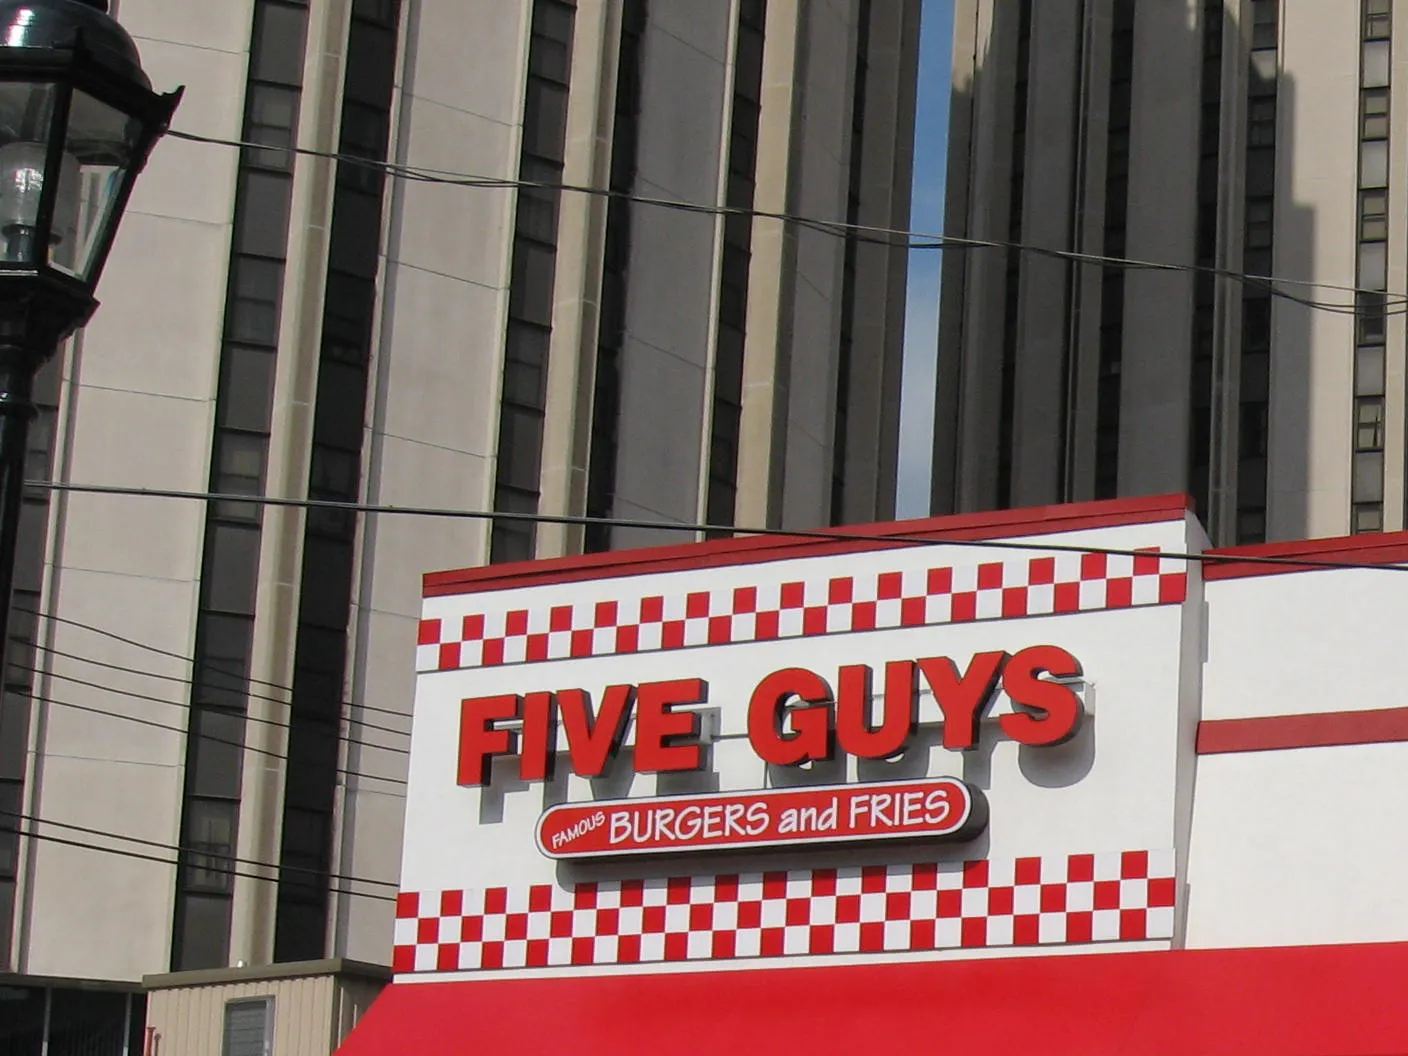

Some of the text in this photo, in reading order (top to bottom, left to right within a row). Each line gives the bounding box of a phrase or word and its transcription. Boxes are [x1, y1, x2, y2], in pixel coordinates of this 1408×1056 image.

[457, 645, 1083, 788] FIVE GUYS
[551, 790, 951, 850] FAMOUS BURGERS and FRIES
